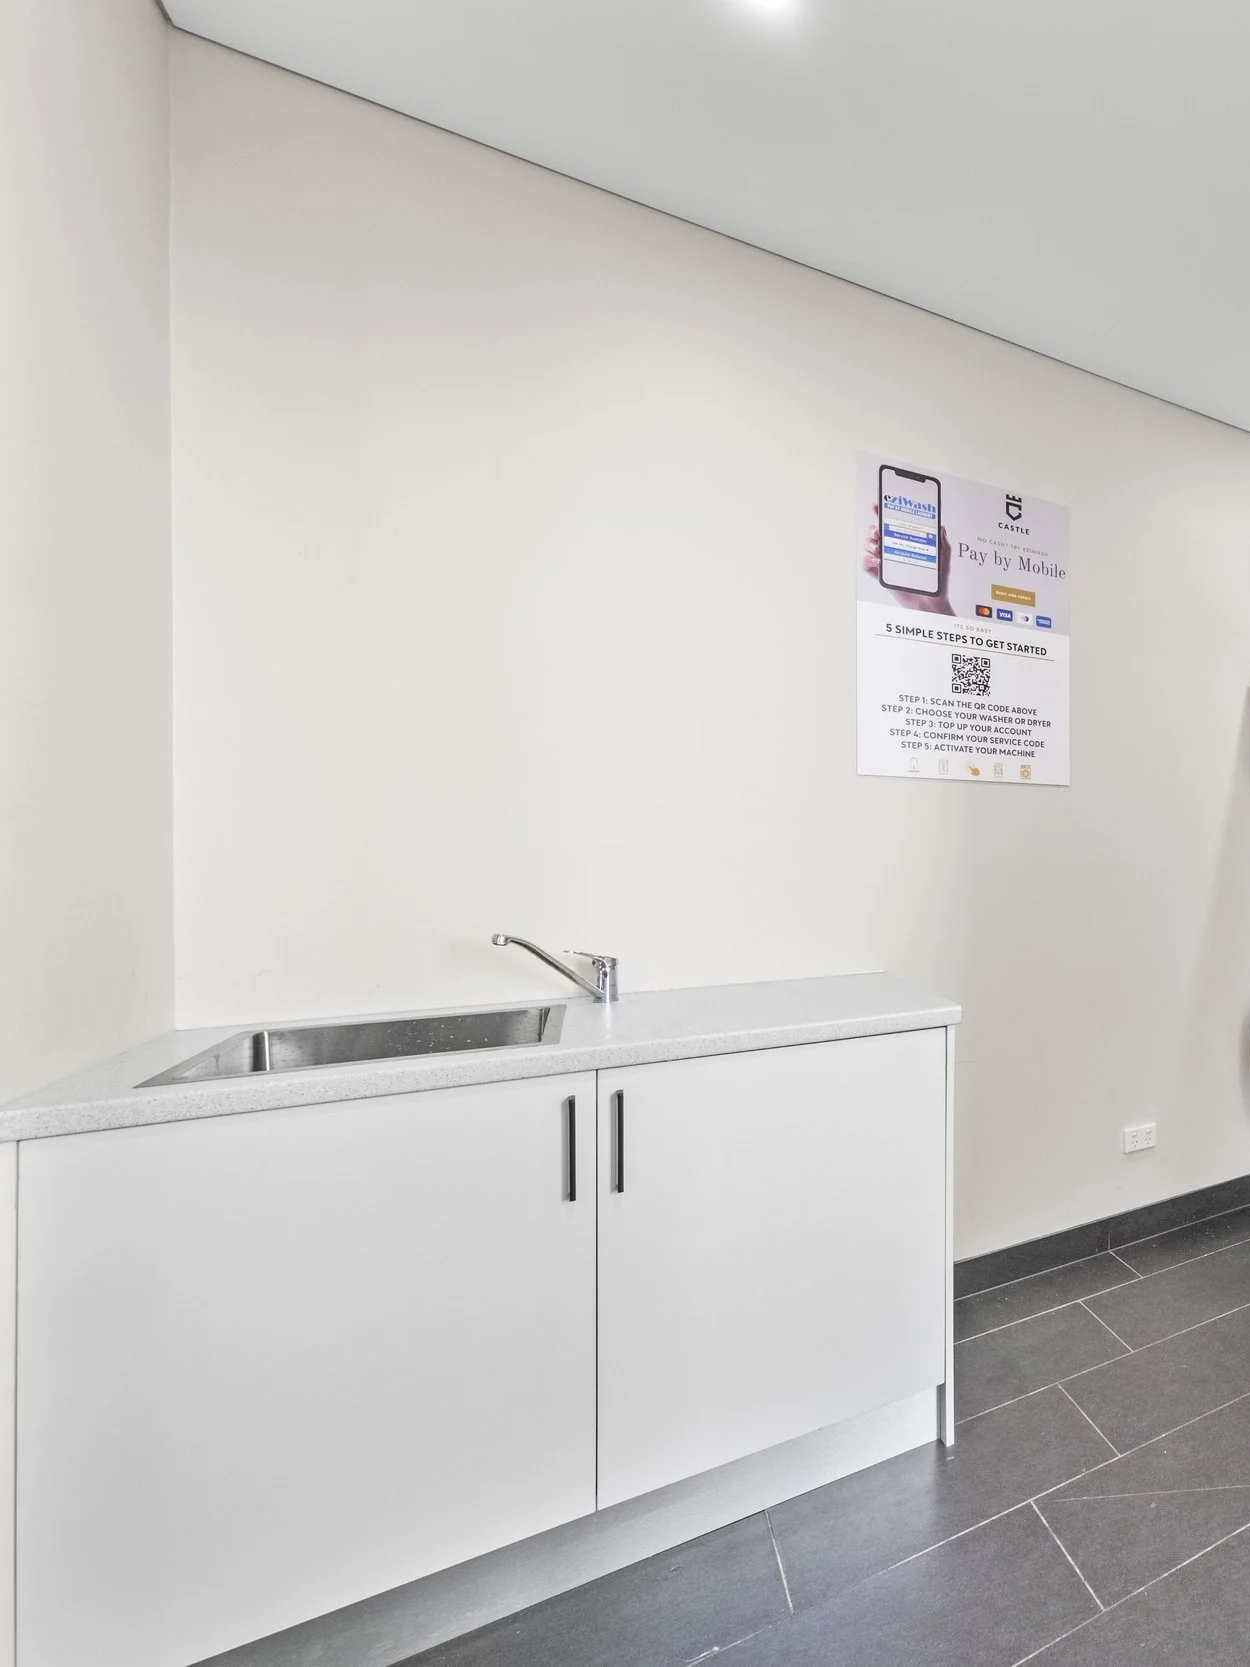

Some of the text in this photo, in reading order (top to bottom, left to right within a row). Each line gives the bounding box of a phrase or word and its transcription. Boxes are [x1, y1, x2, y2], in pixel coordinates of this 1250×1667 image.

[998, 522, 1030, 535] CASTLE
[958, 542, 1066, 579] Pay by Mobile
[886, 624, 1047, 656] 5 SIMPLE STEPS TO GET STARTED
[899, 694, 920, 703] STEP
[930, 698, 955, 707] SCAN
[956, 701, 972, 709] THE
[974, 702, 986, 710] QR
[988, 704, 1010, 713] CODE
[1012, 707, 1037, 716] ABOVE
[882, 704, 903, 713] STEP
[906, 706, 913, 714] 2:
[916, 708, 953, 718] CHOOSE
[955, 712, 977, 720] YOUR
[979, 714, 1013, 724] WASHER
[1028, 719, 1051, 728] DRYER
[905, 718, 1032, 736] STEP 3: TOP UP YOUR ACCOUNT
[890, 728, 911, 737] STEP
[923, 732, 964, 741] CONFIRM
[966, 735, 988, 743] YOUR
[990, 737, 1022, 746] SERVICE
[1024, 740, 1045, 748] CODE
[901, 741, 1036, 758] STEP 5: ACTIVATE YOUR MACHINE
